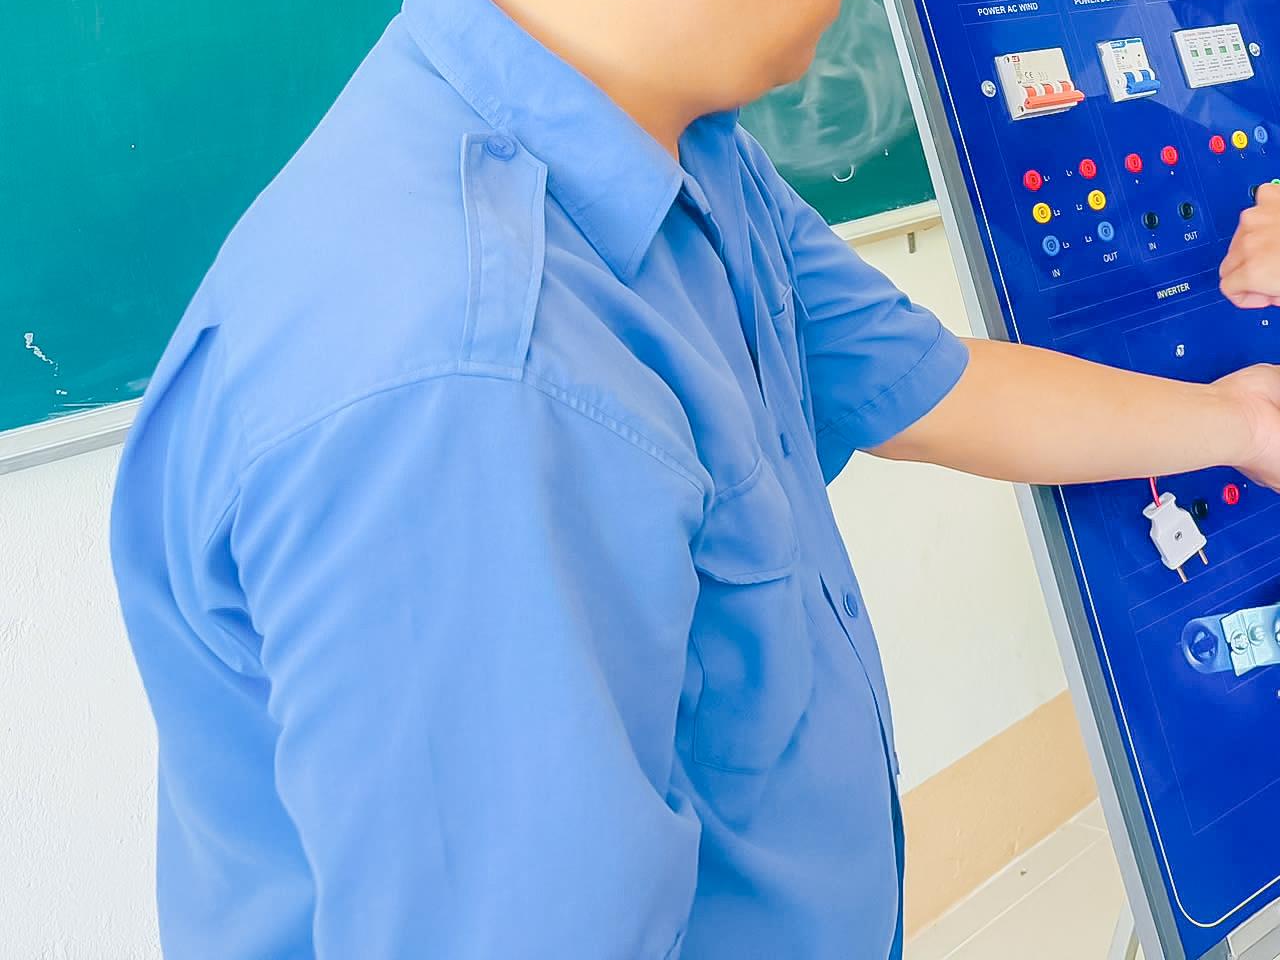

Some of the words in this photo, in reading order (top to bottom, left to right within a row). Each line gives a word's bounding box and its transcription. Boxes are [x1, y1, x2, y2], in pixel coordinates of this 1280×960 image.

[978, 6, 1006, 16] POWER
[1007, 4, 1018, 13] AC
[1019, 2, 1039, 12] WIND
[1184, 230, 1198, 242] OUT
[1148, 242, 1157, 251] IN
[1103, 251, 1118, 263] OUT
[1052, 268, 1061, 278] IN
[1156, 282, 1191, 300] INVERTER
